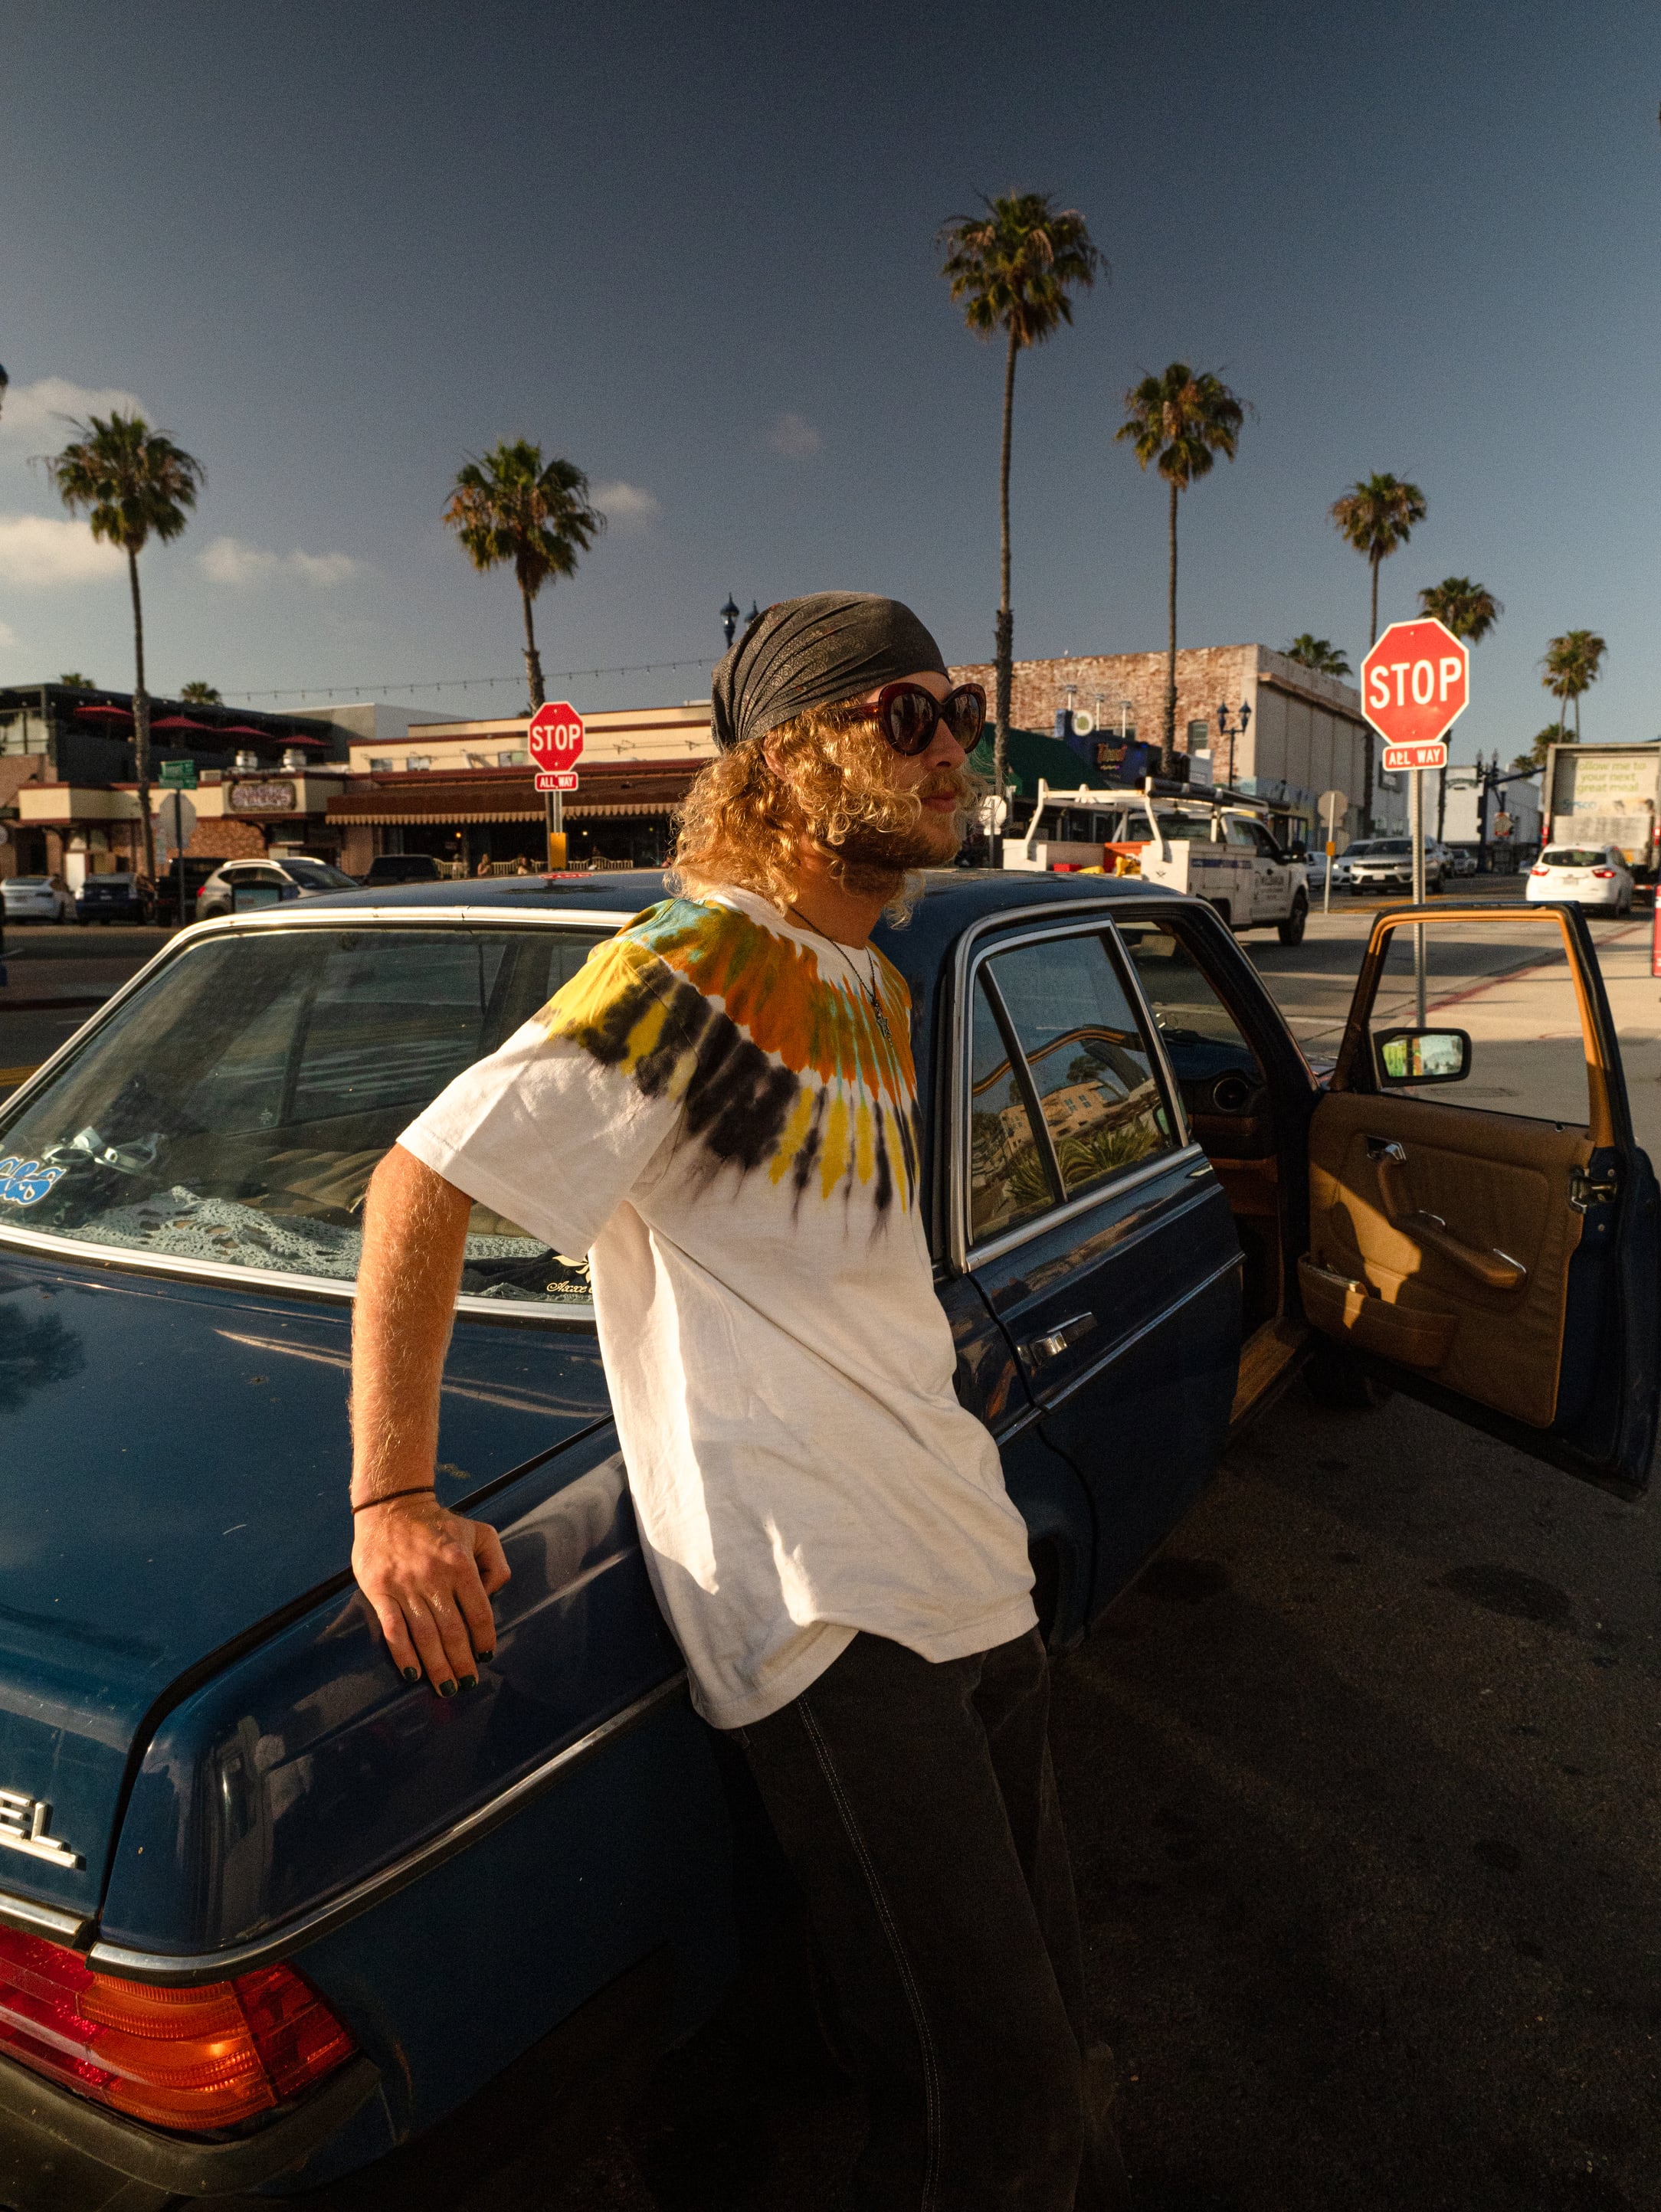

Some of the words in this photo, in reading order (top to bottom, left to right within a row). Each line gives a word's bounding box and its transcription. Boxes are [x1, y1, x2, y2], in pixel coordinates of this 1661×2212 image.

[1369, 656, 1462, 709] STOP
[532, 724, 581, 751] STOP
[1389, 751, 1410, 765] ALL
[1417, 748, 1441, 763] WAY
[1633, 761, 1646, 770] to
[540, 777, 555, 788] ALL
[558, 776, 573, 787] WAY
[1581, 774, 1607, 783] your
[1576, 784, 1607, 794] great
[1610, 783, 1639, 792] meal
